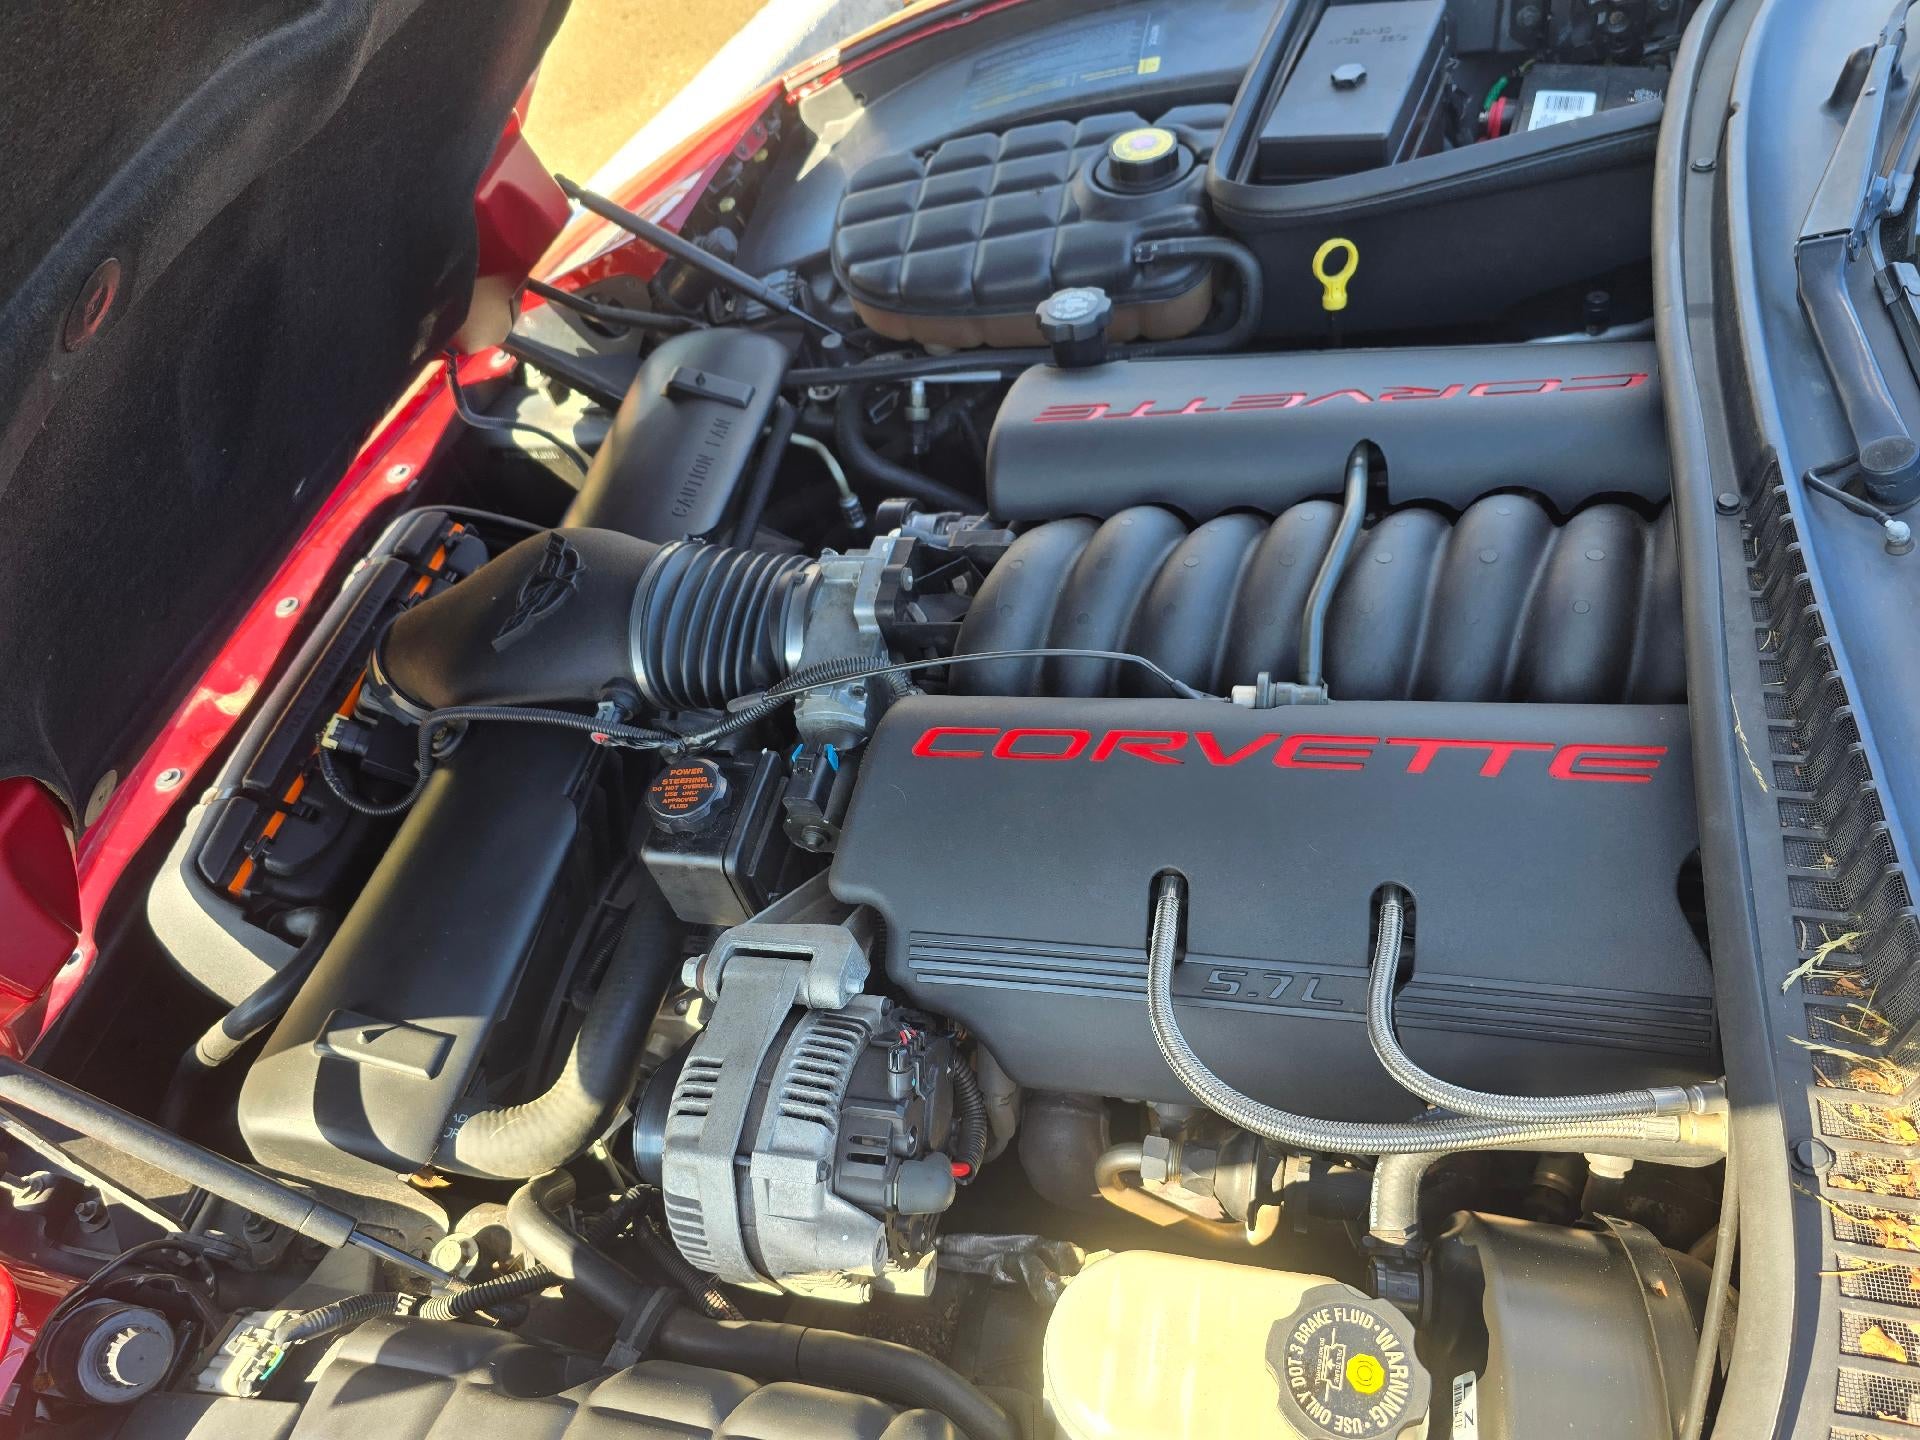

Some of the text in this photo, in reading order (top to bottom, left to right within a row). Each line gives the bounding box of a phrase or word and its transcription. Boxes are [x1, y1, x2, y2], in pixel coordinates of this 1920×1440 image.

[1033, 372, 1649, 422] CORVETTE
[671, 417, 732, 518] CAUTION FAN
[662, 776, 708, 785] STEERING
[670, 767, 704, 776] POWER
[911, 726, 1668, 783] CORVETTE
[1202, 968, 1343, 1005] 5.7L
[1287, 1307, 1375, 1434] USE ONLY DOT 3 BRAKE FLUID
[1369, 1327, 1410, 1428] WARNING
